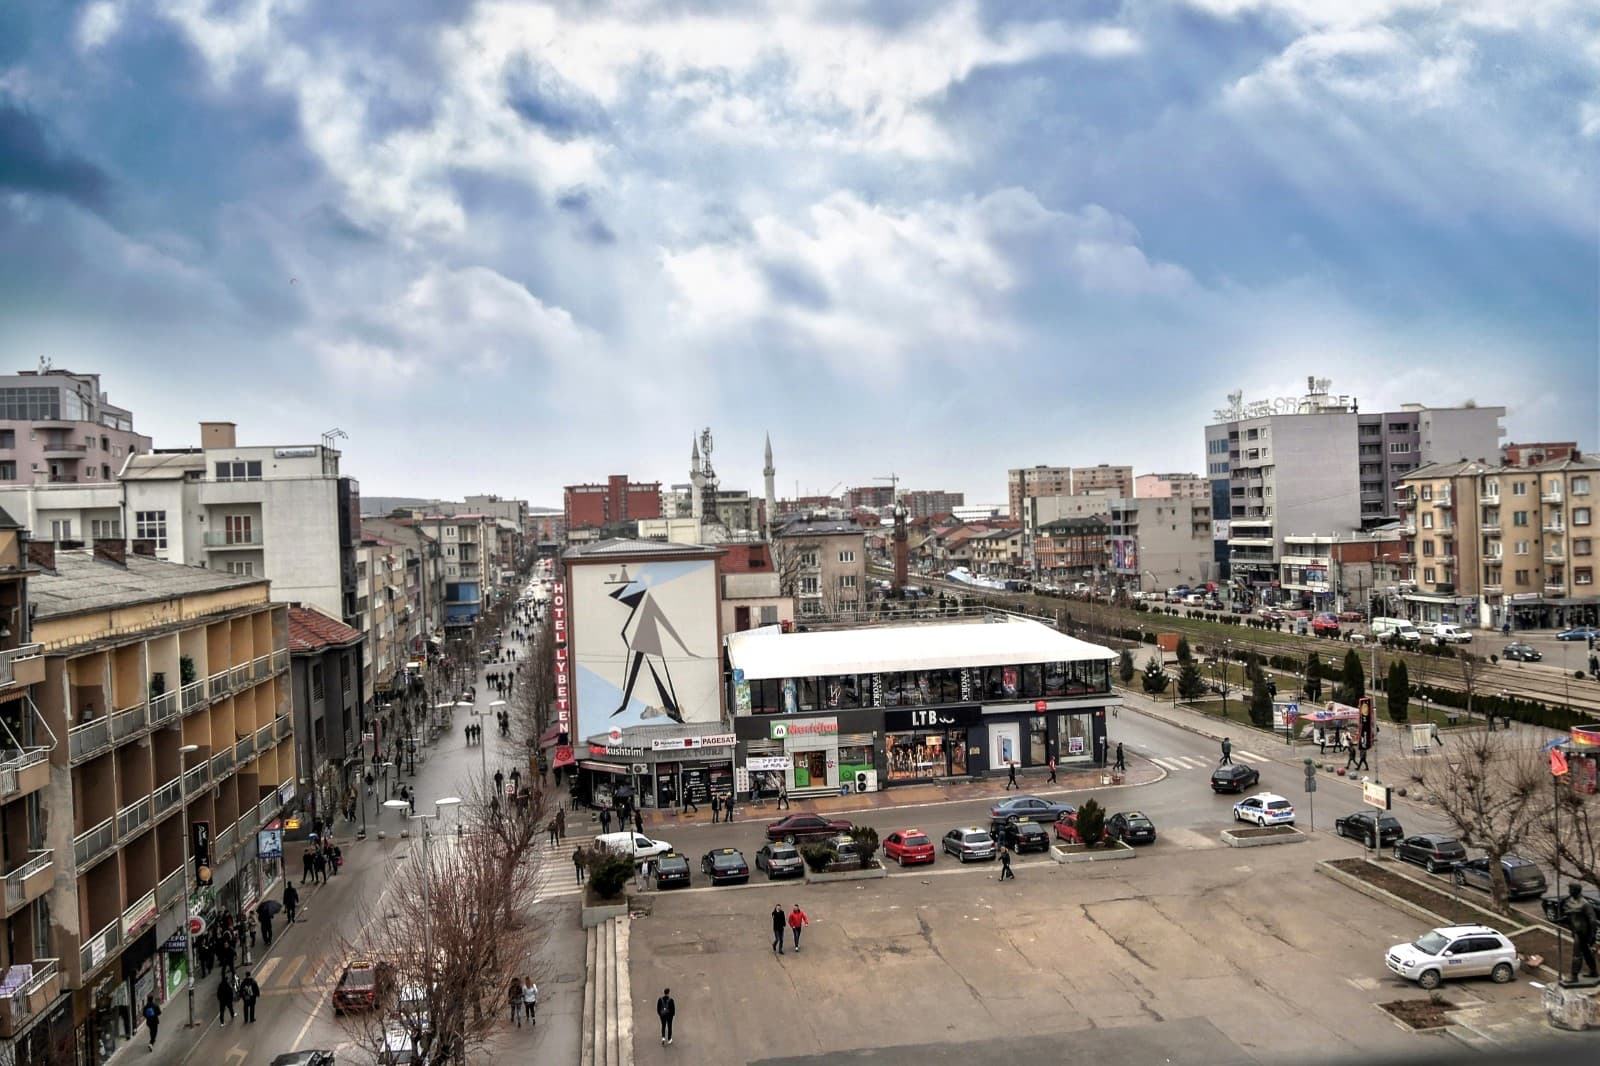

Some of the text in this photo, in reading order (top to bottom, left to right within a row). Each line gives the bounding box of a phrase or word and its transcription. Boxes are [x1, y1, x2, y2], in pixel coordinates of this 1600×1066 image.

[554, 584, 569, 733] HOTEL LYBETEN
[912, 710, 937, 726] LTB
[702, 736, 735, 745] PAGESAT
